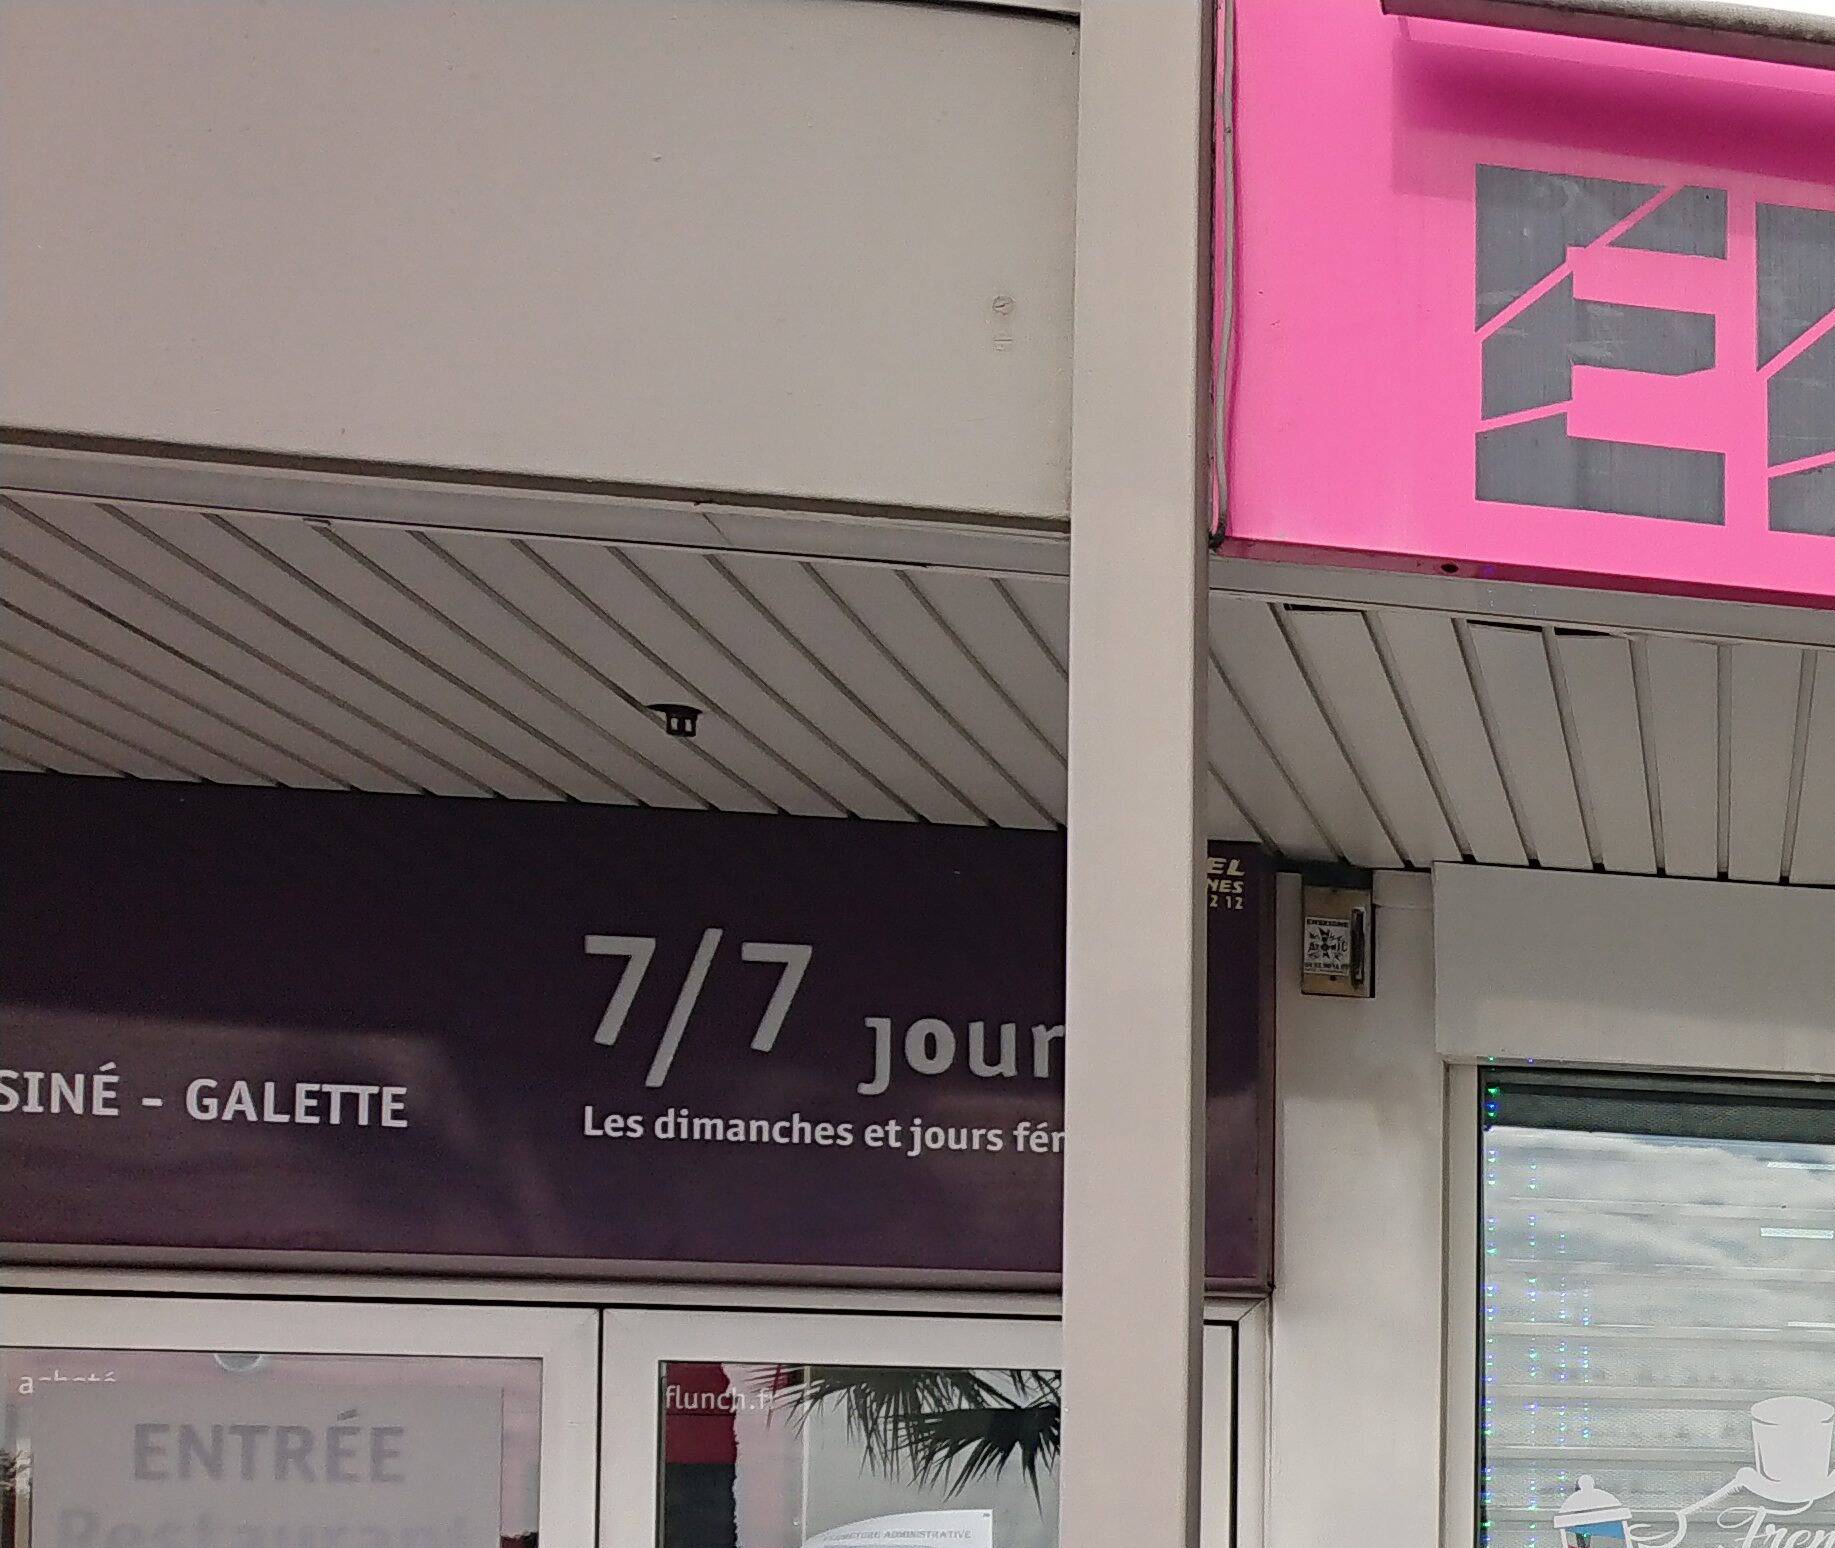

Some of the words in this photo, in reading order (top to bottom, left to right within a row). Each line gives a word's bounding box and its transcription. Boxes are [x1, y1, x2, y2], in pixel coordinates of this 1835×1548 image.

[584, 928, 814, 1088] 7/7
[858, 1013, 1063, 1097] jour
[0, 1061, 120, 1117] SINÉ
[186, 1079, 408, 1128] GALETTE
[584, 1107, 643, 1139] Les
[654, 1110, 853, 1147] dimanches
[863, 1118, 902, 1148] et
[907, 1118, 1003, 1158] jours
[1014, 1121, 1064, 1152] fér
[133, 1409, 404, 1483] ENTRÉE
